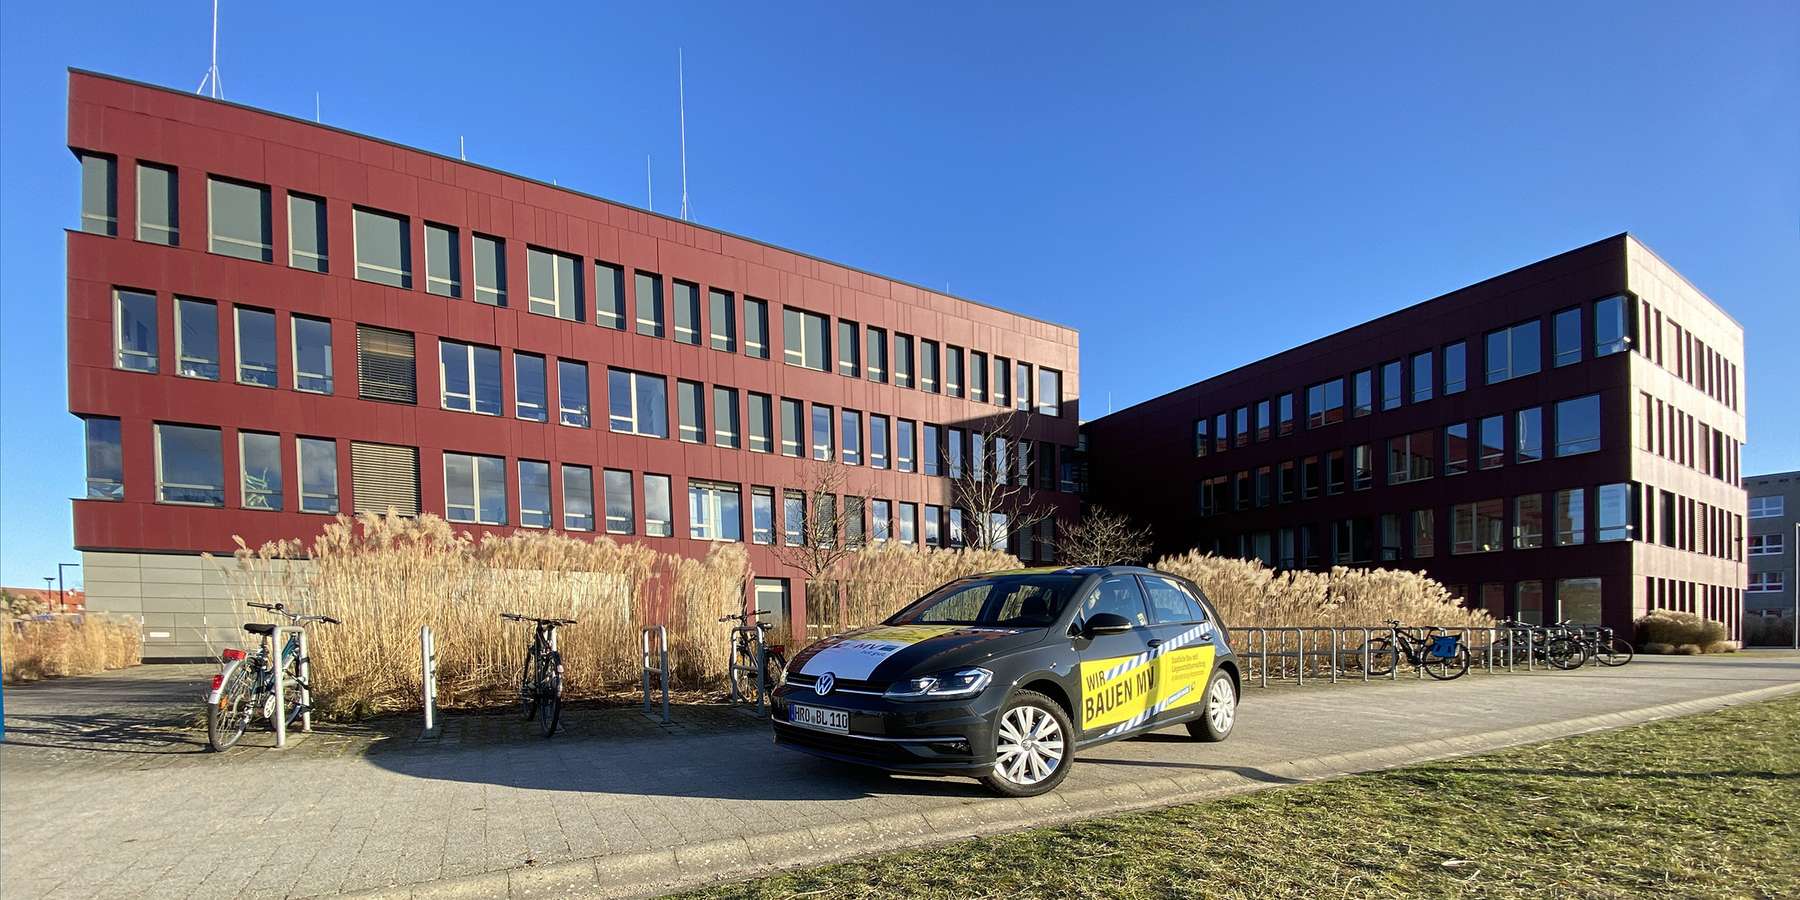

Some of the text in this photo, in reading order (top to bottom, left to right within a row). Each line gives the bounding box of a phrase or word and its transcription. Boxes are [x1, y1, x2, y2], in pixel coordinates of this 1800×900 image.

[1086, 670, 1106, 691] WIR
[1085, 677, 1132, 722] BAUEN
[1136, 665, 1154, 697] MV
[795, 706, 848, 728] HRO BL 110
